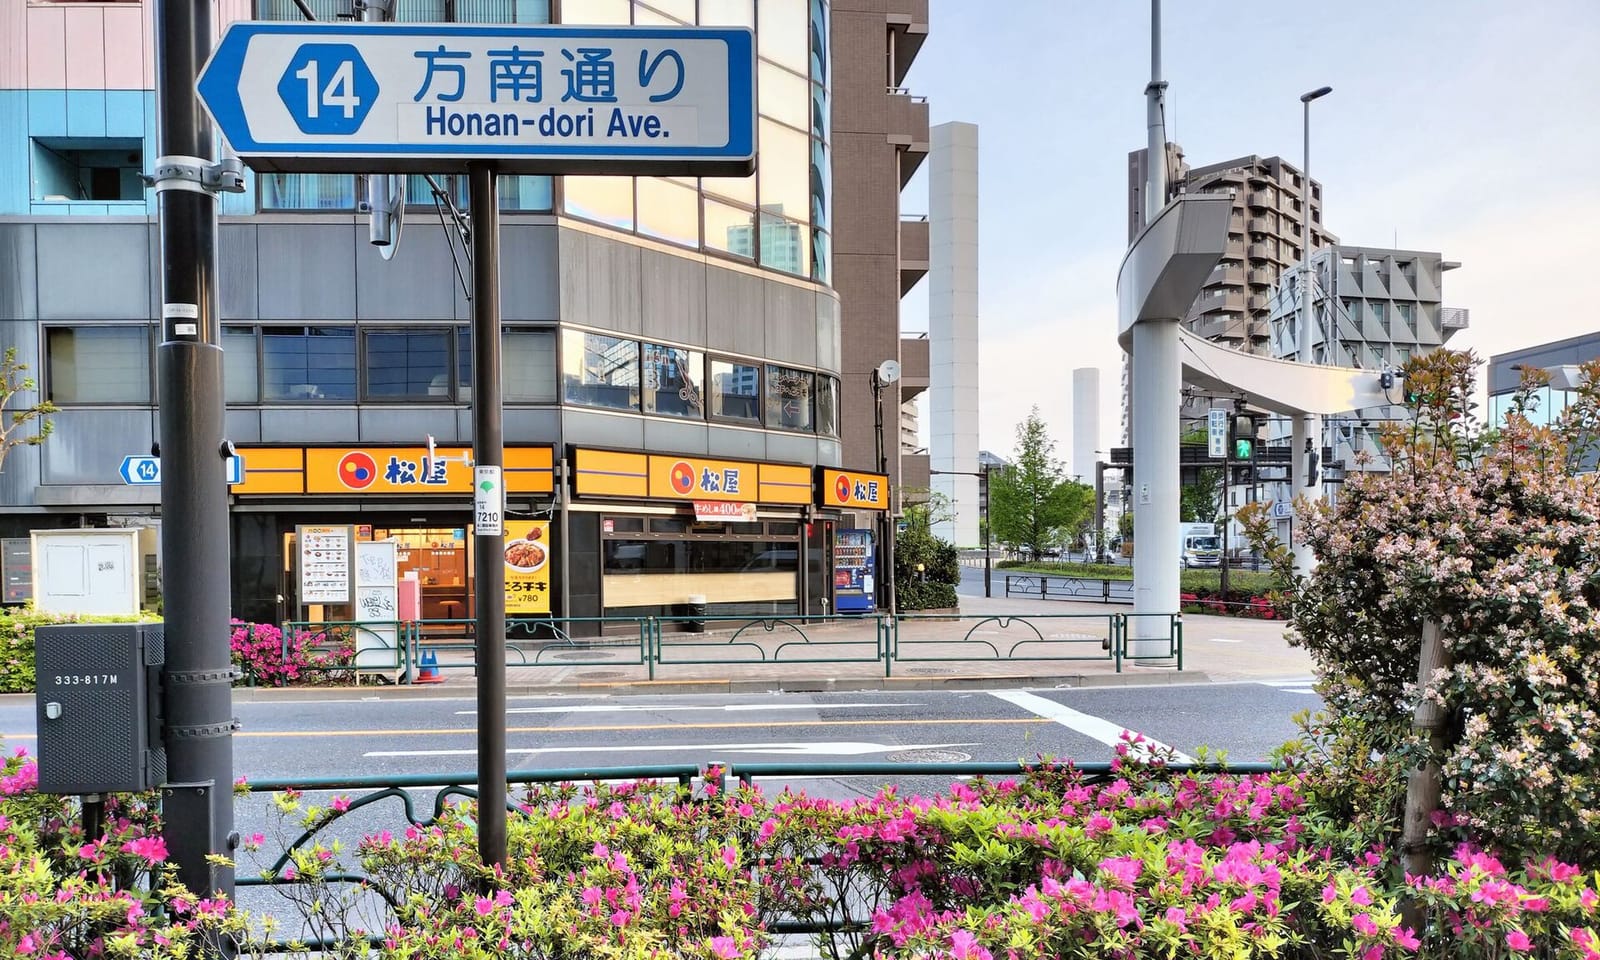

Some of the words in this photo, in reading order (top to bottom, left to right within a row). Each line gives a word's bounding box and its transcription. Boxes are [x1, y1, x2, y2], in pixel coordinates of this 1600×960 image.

[296, 60, 360, 118] 14
[413, 44, 685, 103] 方南通り
[426, 105, 594, 137] Honan-dori
[606, 107, 670, 138] Ave.
[140, 464, 154, 477] 14
[385, 456, 447, 484] 松屋
[701, 467, 739, 493] 松屋
[854, 480, 878, 502] 松屋
[477, 512, 499, 522] 7210
[55, 675, 118, 685] 333-817M
